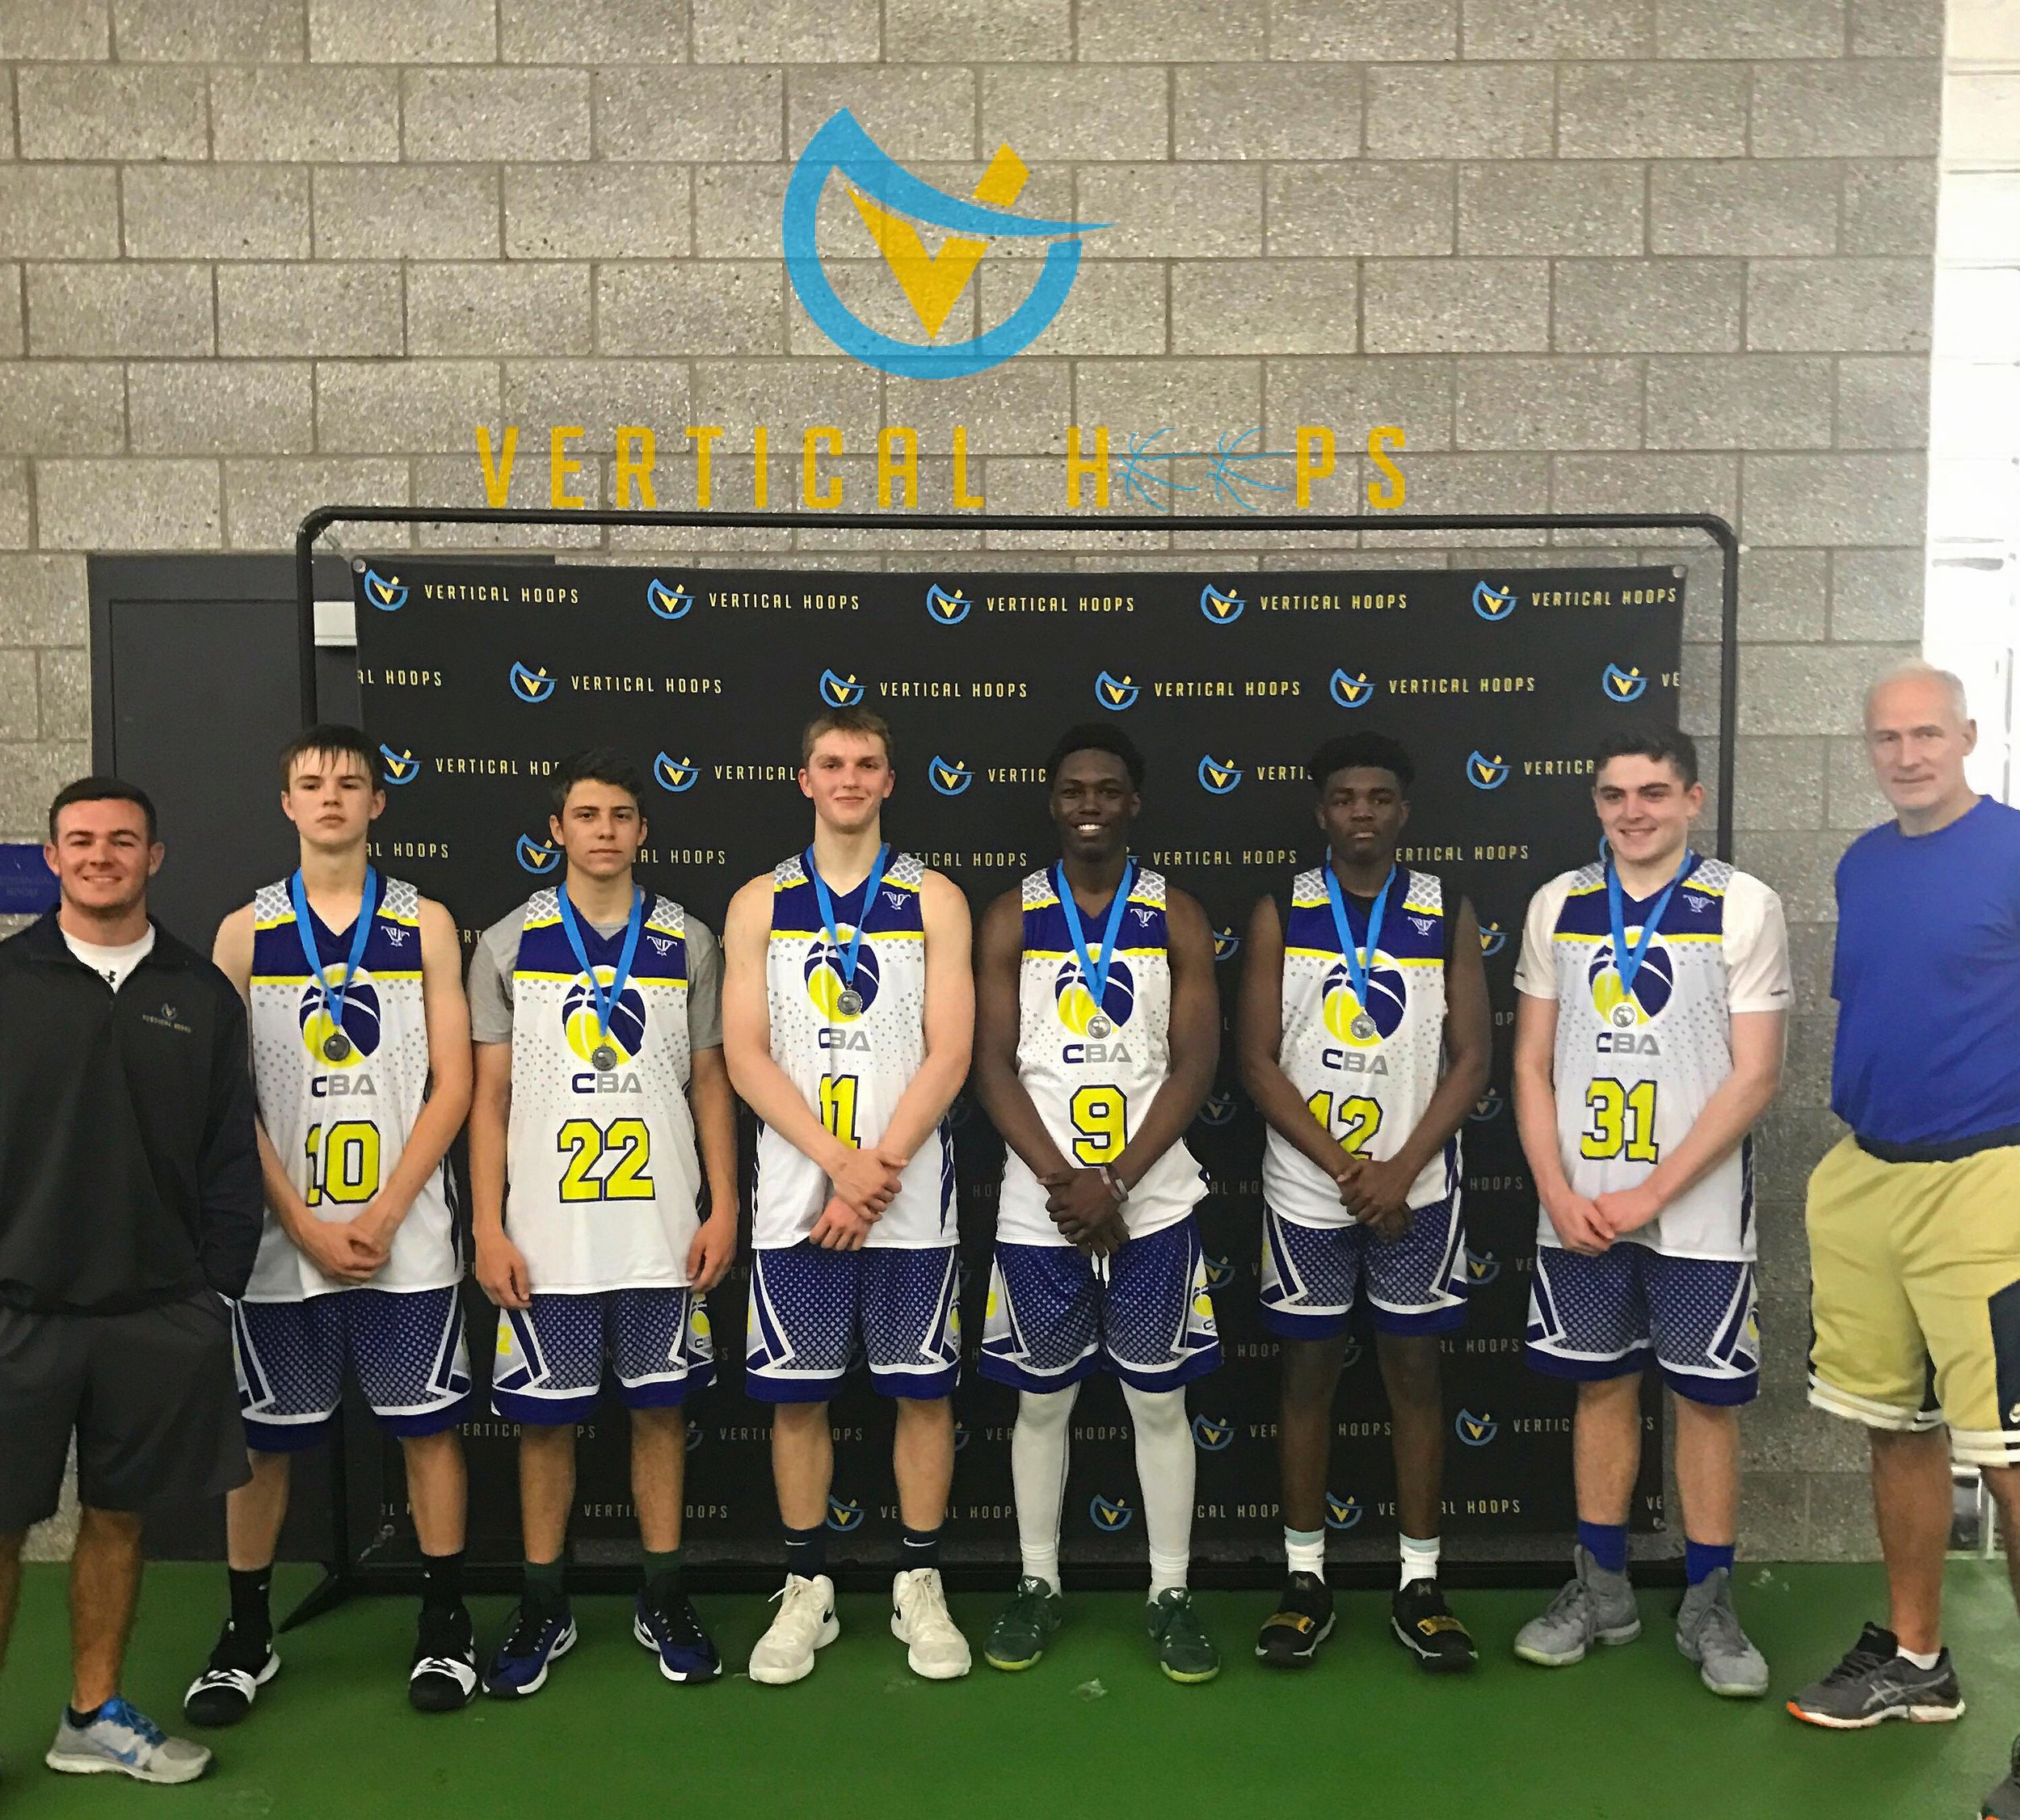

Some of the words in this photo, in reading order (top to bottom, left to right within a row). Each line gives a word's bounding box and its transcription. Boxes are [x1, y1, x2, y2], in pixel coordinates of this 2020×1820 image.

[425, 585, 509, 601] VERTICAL
[522, 588, 578, 603] HOOPS
[709, 593, 791, 609] VERTICAL
[804, 595, 858, 609] HOOPS
[1532, 592, 1610, 606] VERTICAL
[1622, 588, 1676, 605] HOOPS
[987, 597, 1067, 611] VERTICAL
[1079, 597, 1133, 611] HOOPS
[1260, 596, 1340, 610] VERTICAL
[1353, 595, 1406, 609] HOOPS
[386, 670, 441, 686] HOOPS
[571, 676, 654, 692] VERTICAL
[667, 679, 721, 693] HOOPS
[1389, 679, 1468, 693] VERTICAL
[1480, 677, 1534, 692] HOOPS
[881, 683, 961, 697] VERTICAL
[973, 684, 1026, 697] HOOPS
[1155, 682, 1234, 697] VERTICAL
[1246, 681, 1299, 695] HOOPS
[436, 759, 518, 774] VERTICAL
[715, 766, 795, 780] VERTICAL
[1257, 766, 1313, 780] VERTI
[1525, 760, 1593, 775] VERTICA
[988, 769, 1046, 782] VERTIC
[394, 843, 448, 857] HOOPS
[671, 850, 725, 864] HOOPS
[1154, 852, 1231, 865] VERTICAL
[1244, 850, 1296, 864] HOOPS
[1396, 847, 1462, 862] ERTICAL
[1475, 845, 1528, 860] HOOPS
[915, 853, 962, 866] TICAL
[974, 853, 1026, 866] HOOPS
[819, 1027, 871, 1051] CBA
[1596, 1032, 1661, 1056] CBA
[1063, 1043, 1133, 1064] CBA
[1322, 1048, 1389, 1076] CBA
[311, 1074, 377, 1097] CBA
[572, 1072, 643, 1093] CBA
[1070, 1084, 1128, 1166] 9
[1307, 1089, 1383, 1161] 12
[1580, 1077, 1659, 1164] 31
[558, 1118, 655, 1203] 22
[1471, 1177, 1522, 1190] HOOPS
[1467, 1339, 1518, 1352] HOOPS
[1075, 1426, 1127, 1439] HOOPS
[1339, 1422, 1391, 1436] HOOPS
[1467, 1500, 1520, 1513] HOOPS
